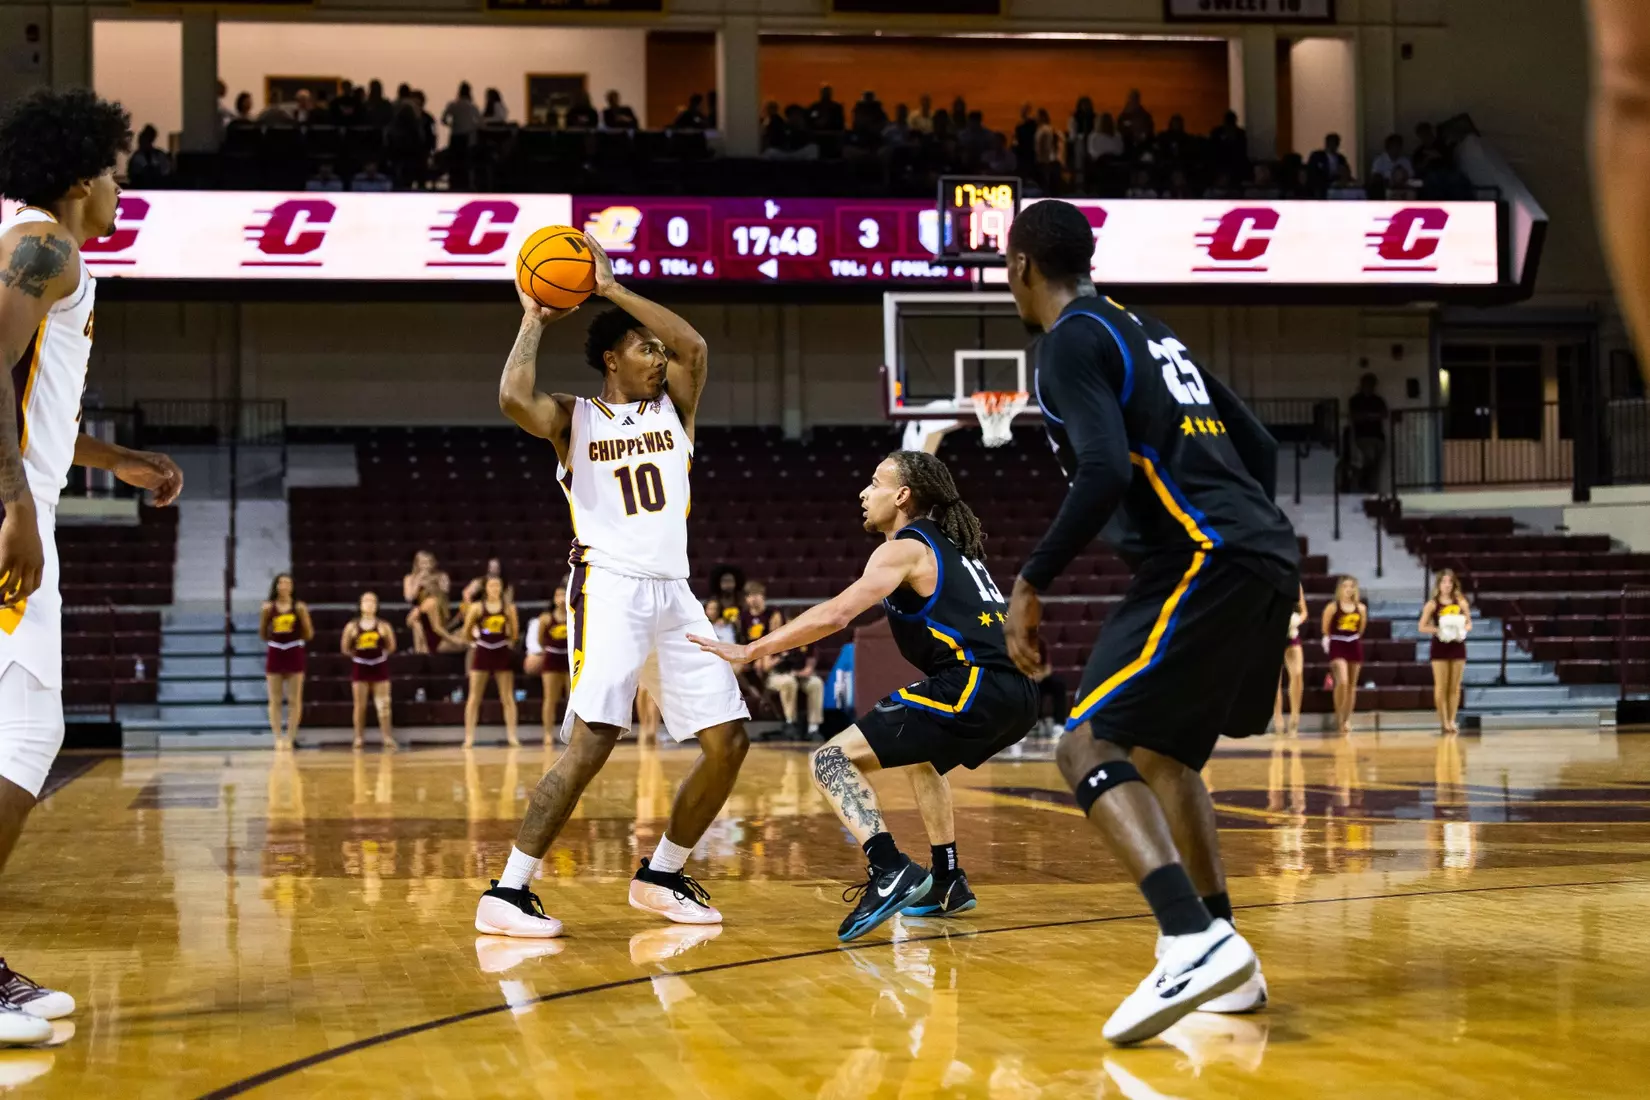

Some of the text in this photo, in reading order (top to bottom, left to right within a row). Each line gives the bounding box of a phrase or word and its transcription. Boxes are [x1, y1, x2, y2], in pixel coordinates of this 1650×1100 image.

[955, 184, 1013, 209] 17:48
[667, 216, 689, 248] 0
[732, 226, 818, 256] 17:48
[858, 218, 880, 249] 3
[702, 260, 715, 276] 4
[871, 261, 884, 277] 4
[1147, 337, 1210, 405] 25
[589, 430, 674, 461] CHIPPEWAS
[614, 462, 666, 516] 10
[961, 555, 1005, 603] 13
[819, 748, 838, 759] WE
[822, 764, 841, 783] ONES
